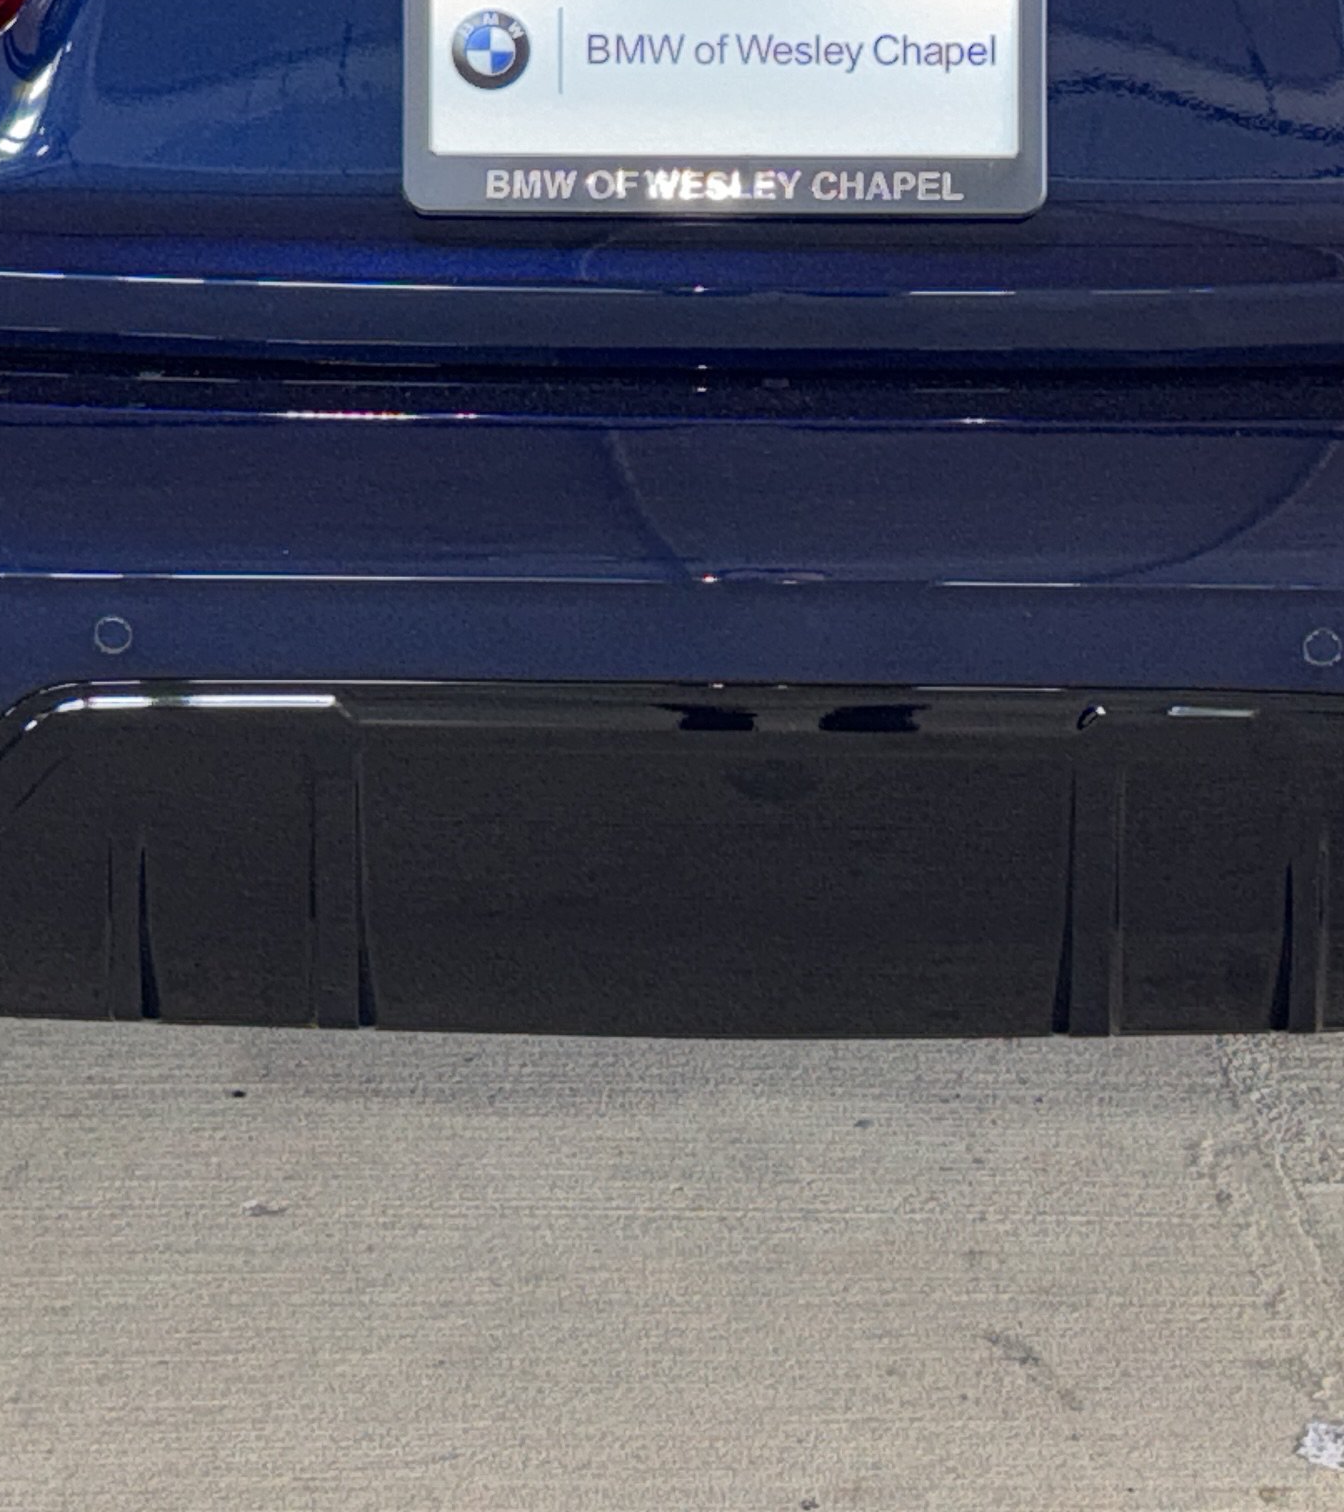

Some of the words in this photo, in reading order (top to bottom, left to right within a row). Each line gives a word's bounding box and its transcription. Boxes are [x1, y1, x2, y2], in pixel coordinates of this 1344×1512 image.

[587, 33, 685, 65] BMW
[694, 33, 730, 65] of
[735, 33, 863, 73] Wesley
[873, 33, 996, 73] Chapel
[485, 169, 577, 200] BMW
[586, 169, 638, 200] OF
[644, 169, 801, 200] WESLEY
[811, 170, 964, 201] CHAPEL
